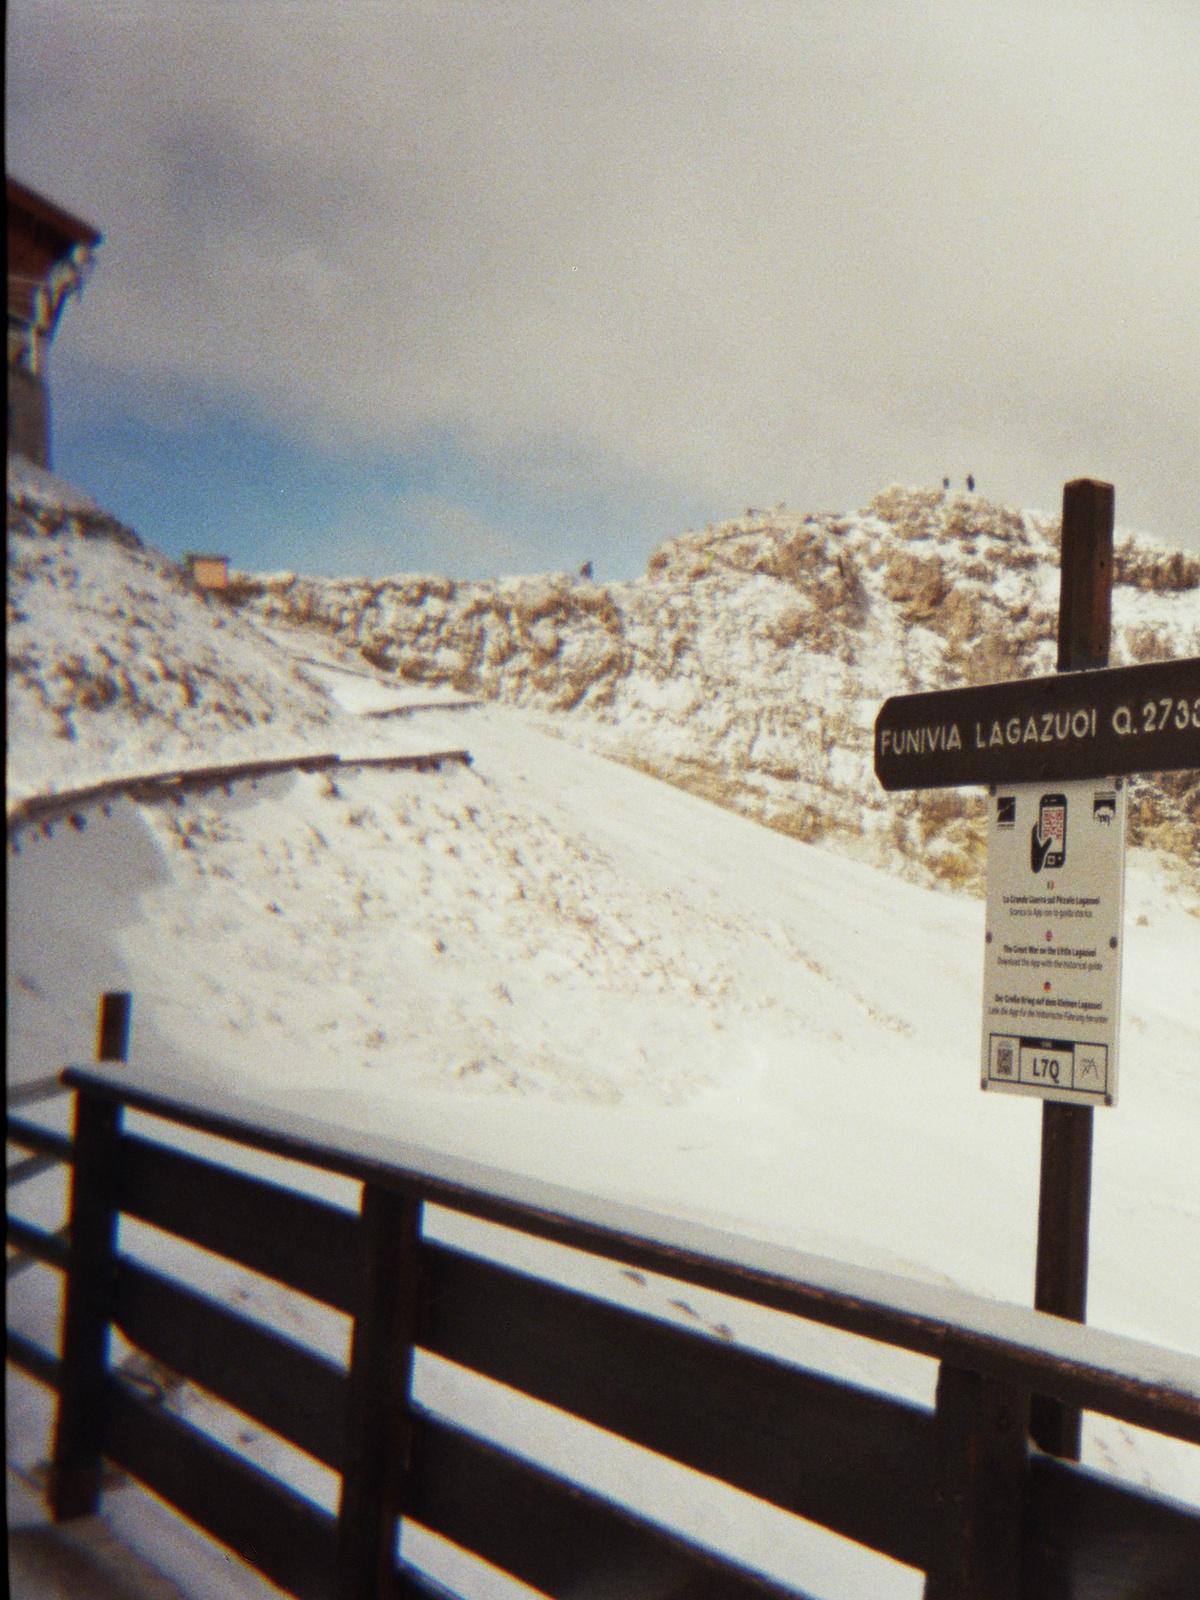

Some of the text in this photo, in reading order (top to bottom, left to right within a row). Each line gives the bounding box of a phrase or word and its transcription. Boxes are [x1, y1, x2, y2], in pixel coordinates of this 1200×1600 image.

[881, 723, 962, 756] FUNIVIA
[976, 708, 1097, 748] LAGAZUOI
[1033, 1058, 1060, 1084] L7Q
